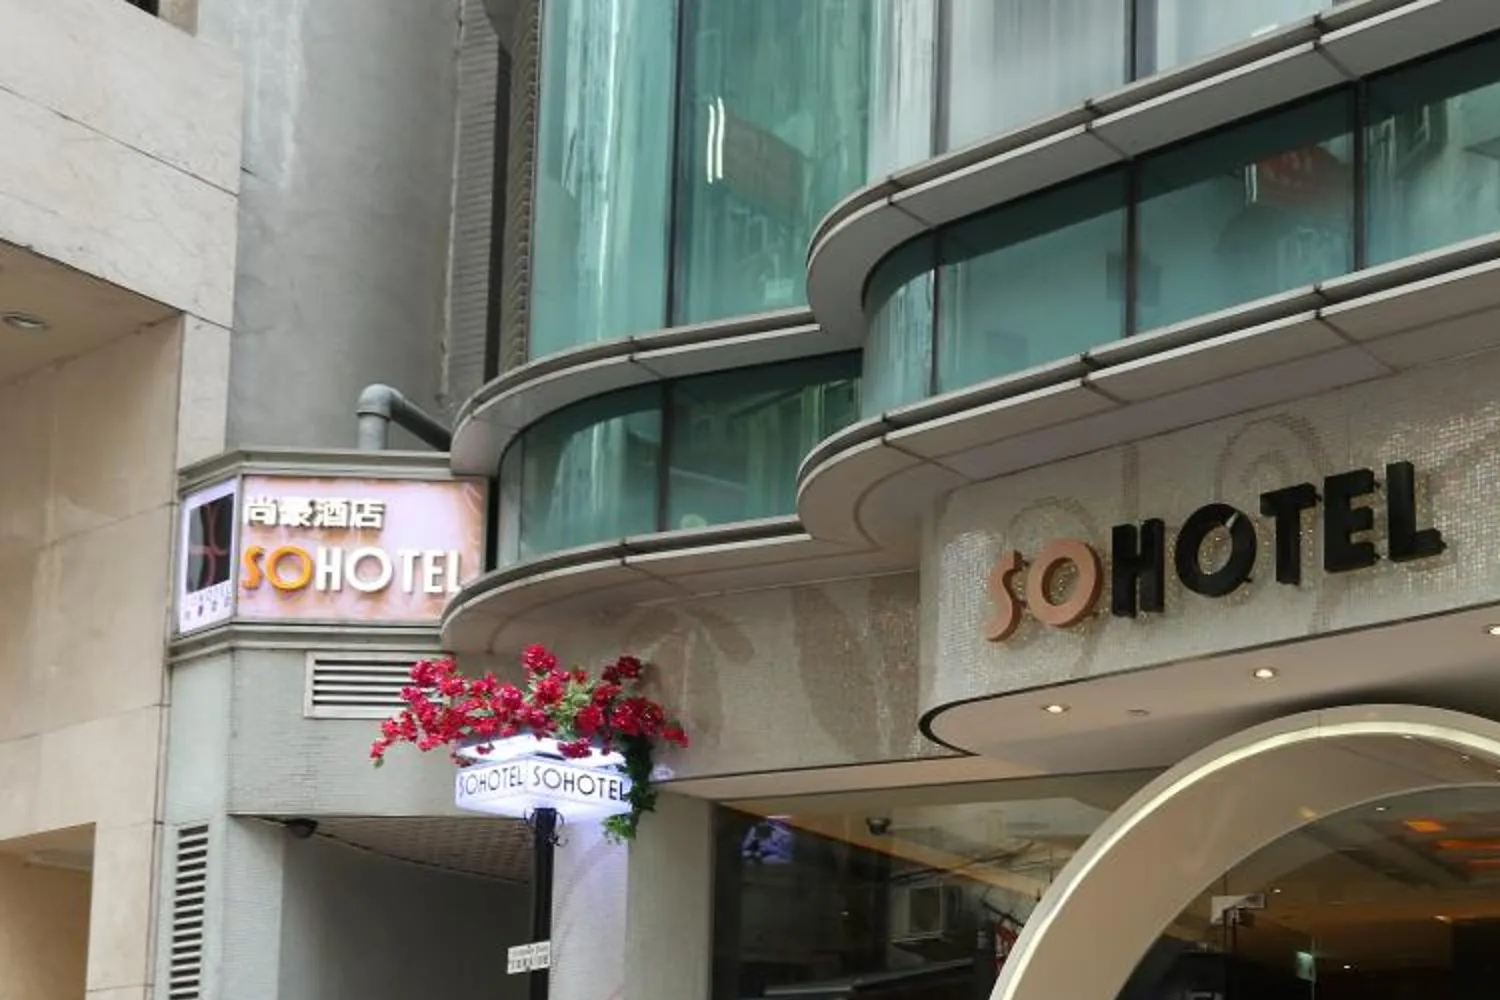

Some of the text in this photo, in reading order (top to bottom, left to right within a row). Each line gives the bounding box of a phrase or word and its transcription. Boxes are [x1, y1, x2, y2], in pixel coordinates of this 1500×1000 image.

[245, 497, 385, 529] 尚豪酒店
[986, 461, 1447, 642] SOHOTEL
[242, 545, 462, 594] SOHOTEL
[458, 766, 523, 798] SOHOTEL
[533, 766, 626, 801] SOHOTEL
